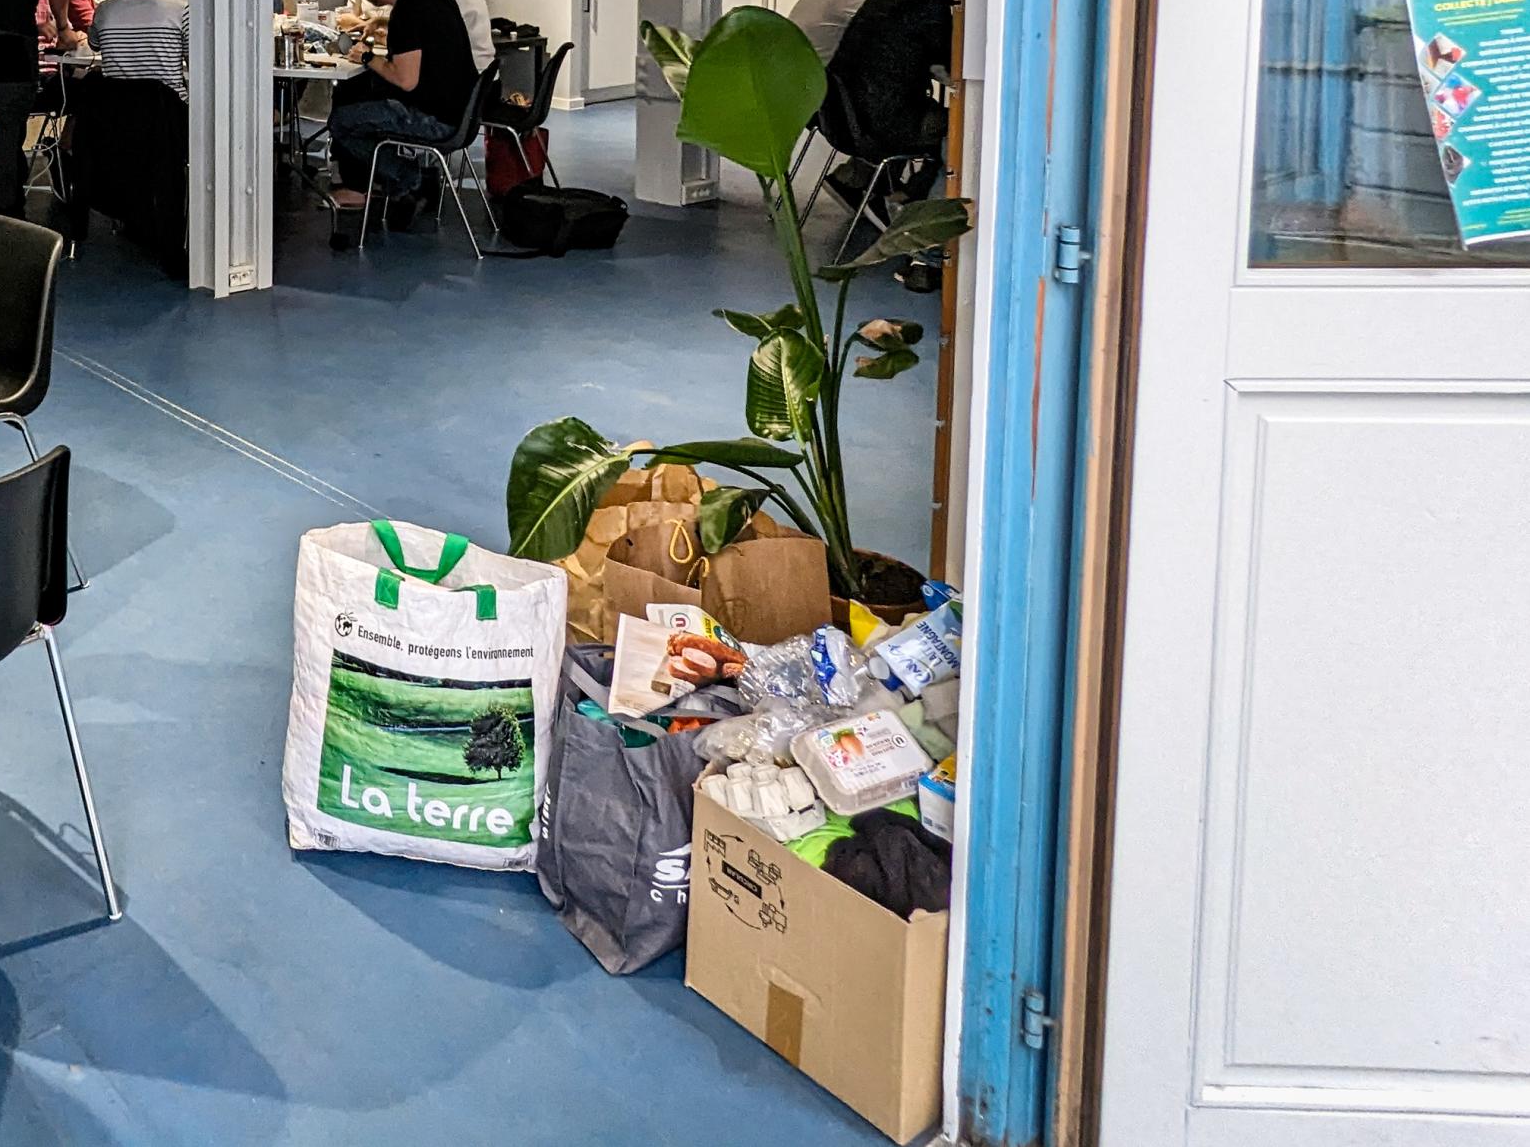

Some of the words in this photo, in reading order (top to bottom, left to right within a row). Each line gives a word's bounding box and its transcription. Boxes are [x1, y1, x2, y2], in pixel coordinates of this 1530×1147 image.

[408, 643, 462, 660] protégeons
[466, 646, 534, 660] l'environnement
[341, 764, 393, 819] La
[407, 782, 515, 835] terre
